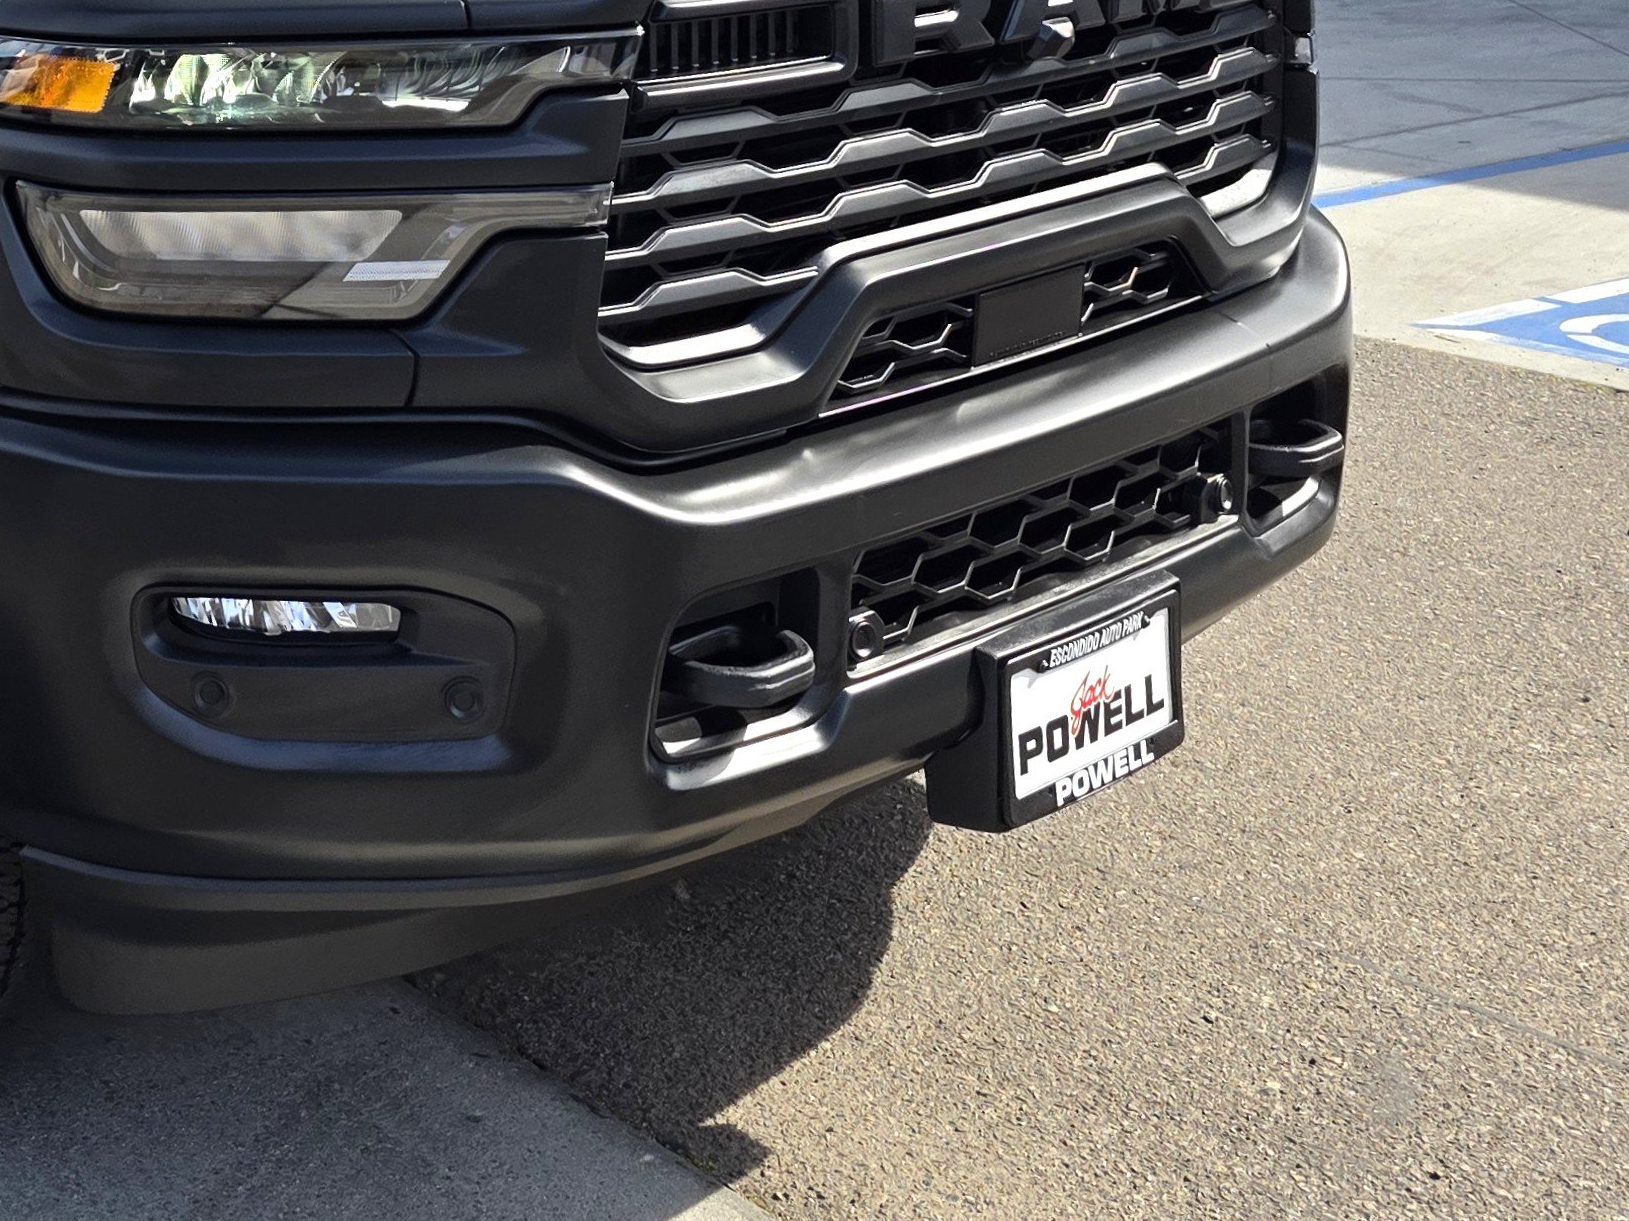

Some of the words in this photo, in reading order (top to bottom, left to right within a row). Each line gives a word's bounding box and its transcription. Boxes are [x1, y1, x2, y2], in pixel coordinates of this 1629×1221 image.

[1049, 631, 1100, 668] ESCONDIDO
[1099, 622, 1123, 647] AUTO
[1122, 611, 1145, 637] PARK
[1018, 674, 1164, 776] POWELL
[1070, 665, 1115, 736] Jack
[1055, 739, 1155, 807] POWELL
